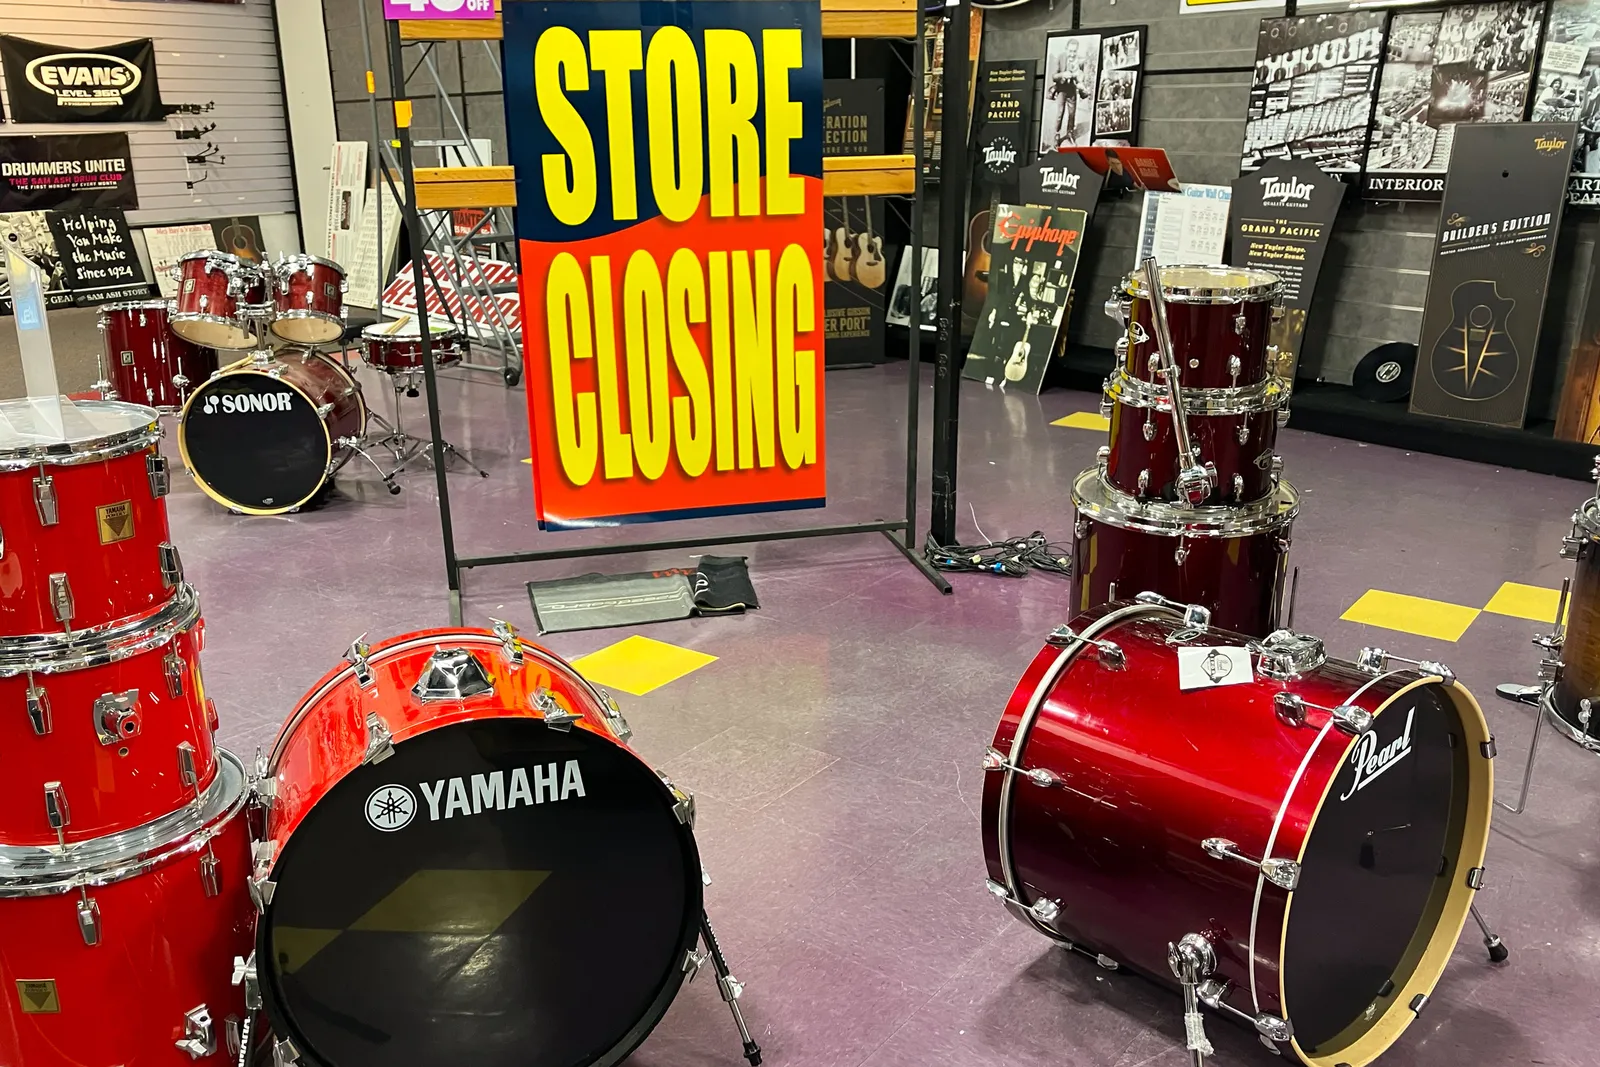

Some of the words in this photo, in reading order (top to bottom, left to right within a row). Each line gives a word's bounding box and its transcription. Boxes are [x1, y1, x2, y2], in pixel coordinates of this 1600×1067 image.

[40, 66, 128, 86] EVANS
[56, 89, 92, 97] LEVEL
[93, 89, 120, 97] 360
[534, 25, 805, 226] STORE
[823, 130, 868, 144] ECTION
[1534, 137, 1567, 152] Taylor
[982, 145, 1017, 166] Taylor
[1, 160, 82, 177] DRUMMERS
[85, 158, 126, 173] UNITE!
[9, 178, 28, 186] THE
[31, 177, 51, 185] SAM
[54, 176, 72, 184] ASH
[74, 175, 97, 183] DRUM
[100, 173, 122, 181] CLUB
[1039, 167, 1080, 189] Taylor
[1368, 178, 1444, 191] INTERIOR
[1205, 188, 1217, 199] Wall
[1260, 176, 1315, 202] Taylor
[62, 214, 117, 233] Helping
[1241, 224, 1276, 234] GRAND
[1280, 227, 1321, 237] PACIFIC
[1442, 222, 1498, 243] BUILDER'S
[1502, 213, 1551, 232] EDITION
[66, 234, 90, 248] You
[92, 229, 122, 246] Make
[998, 211, 1079, 256] Epiphone
[72, 247, 91, 263] the
[93, 247, 126, 262] Music
[1285, 245, 1306, 253] Shape.
[76, 266, 106, 280] Since
[108, 265, 133, 279] 1924
[87, 293, 104, 301] SAM
[106, 291, 121, 299] ASH
[122, 288, 148, 296] STORY
[840, 316, 866, 331] PORT
[546, 243, 816, 486] CLOSING
[221, 392, 292, 414] SONOR
[105, 505, 126, 514] YAMAHA
[1340, 706, 1415, 801] Pearl
[419, 759, 586, 821] YAMAHA
